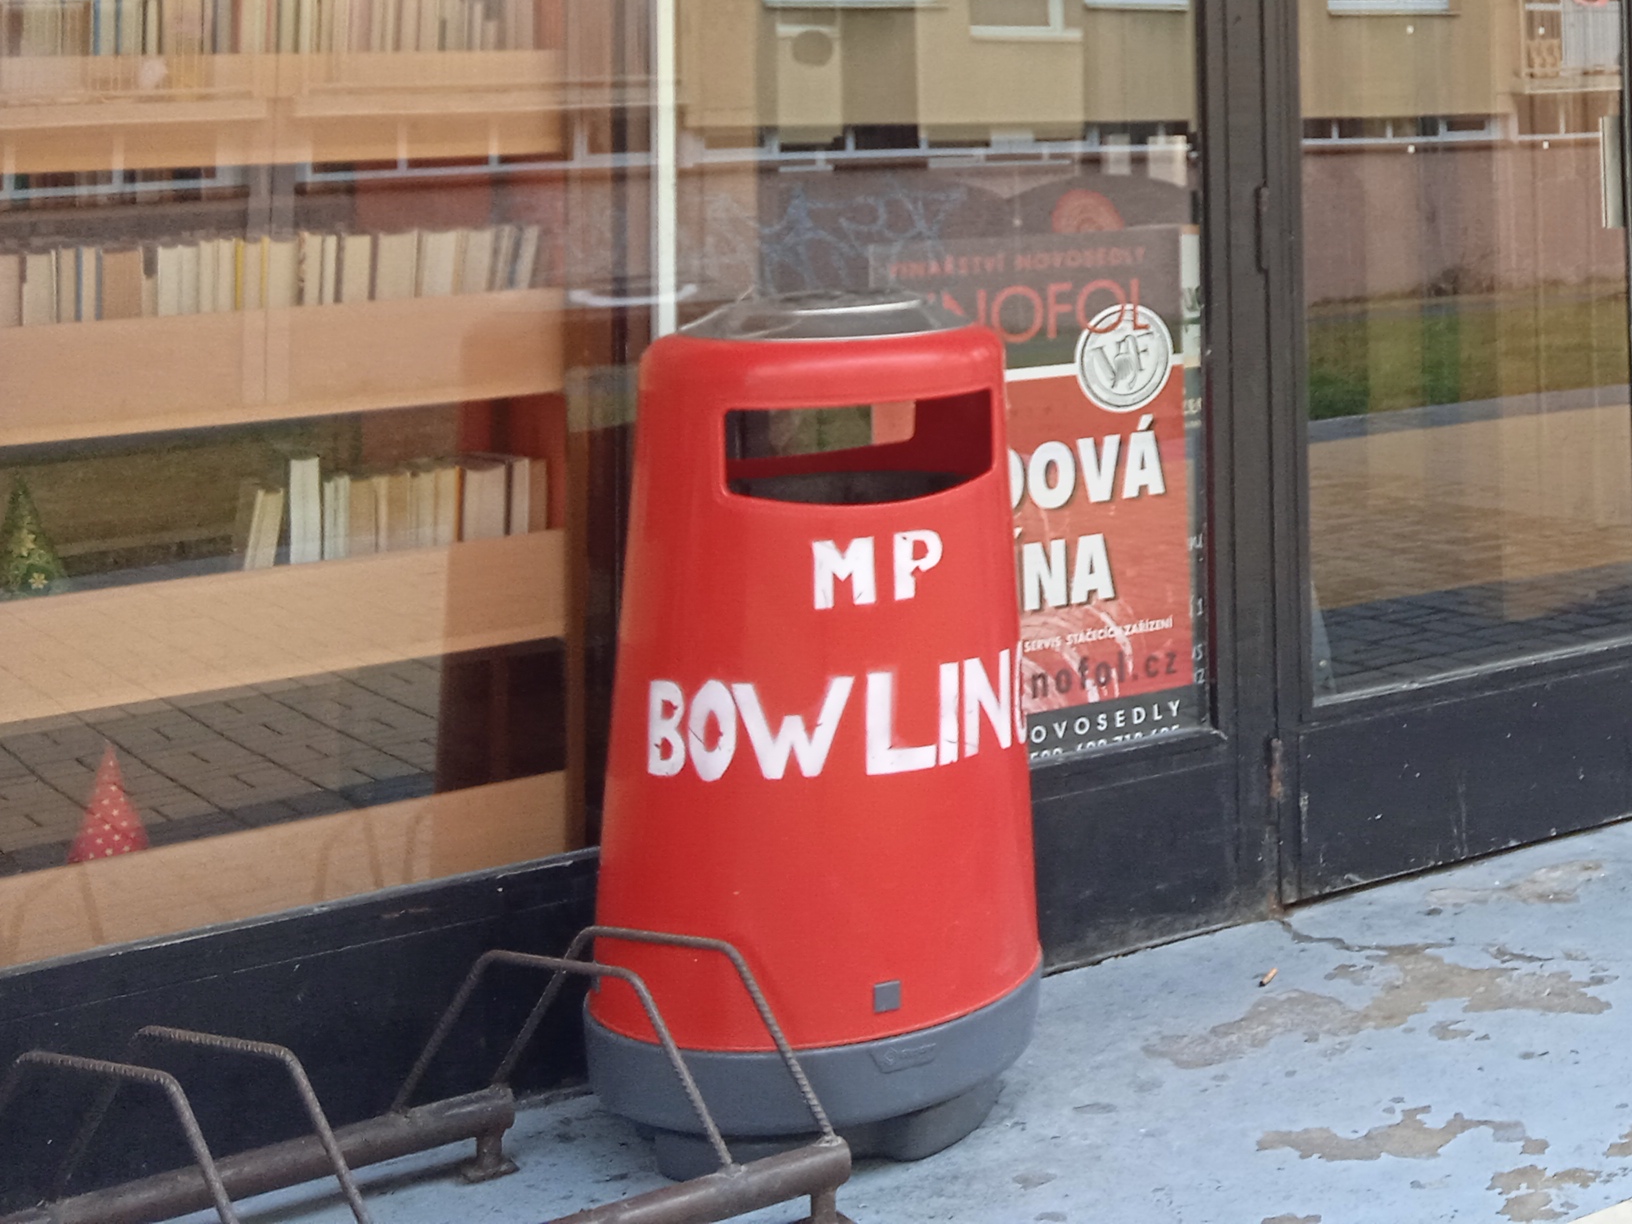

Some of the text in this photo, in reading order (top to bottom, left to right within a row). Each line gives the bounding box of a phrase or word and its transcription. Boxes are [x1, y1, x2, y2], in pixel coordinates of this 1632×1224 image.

[1015, 246, 1146, 271] NOVOSEDLY
[1014, 526, 1116, 612] NA
[1024, 637, 1062, 653] SERVIS
[1031, 650, 1179, 700] nofol.cz
[1031, 699, 1181, 744] OVOSEDLY
